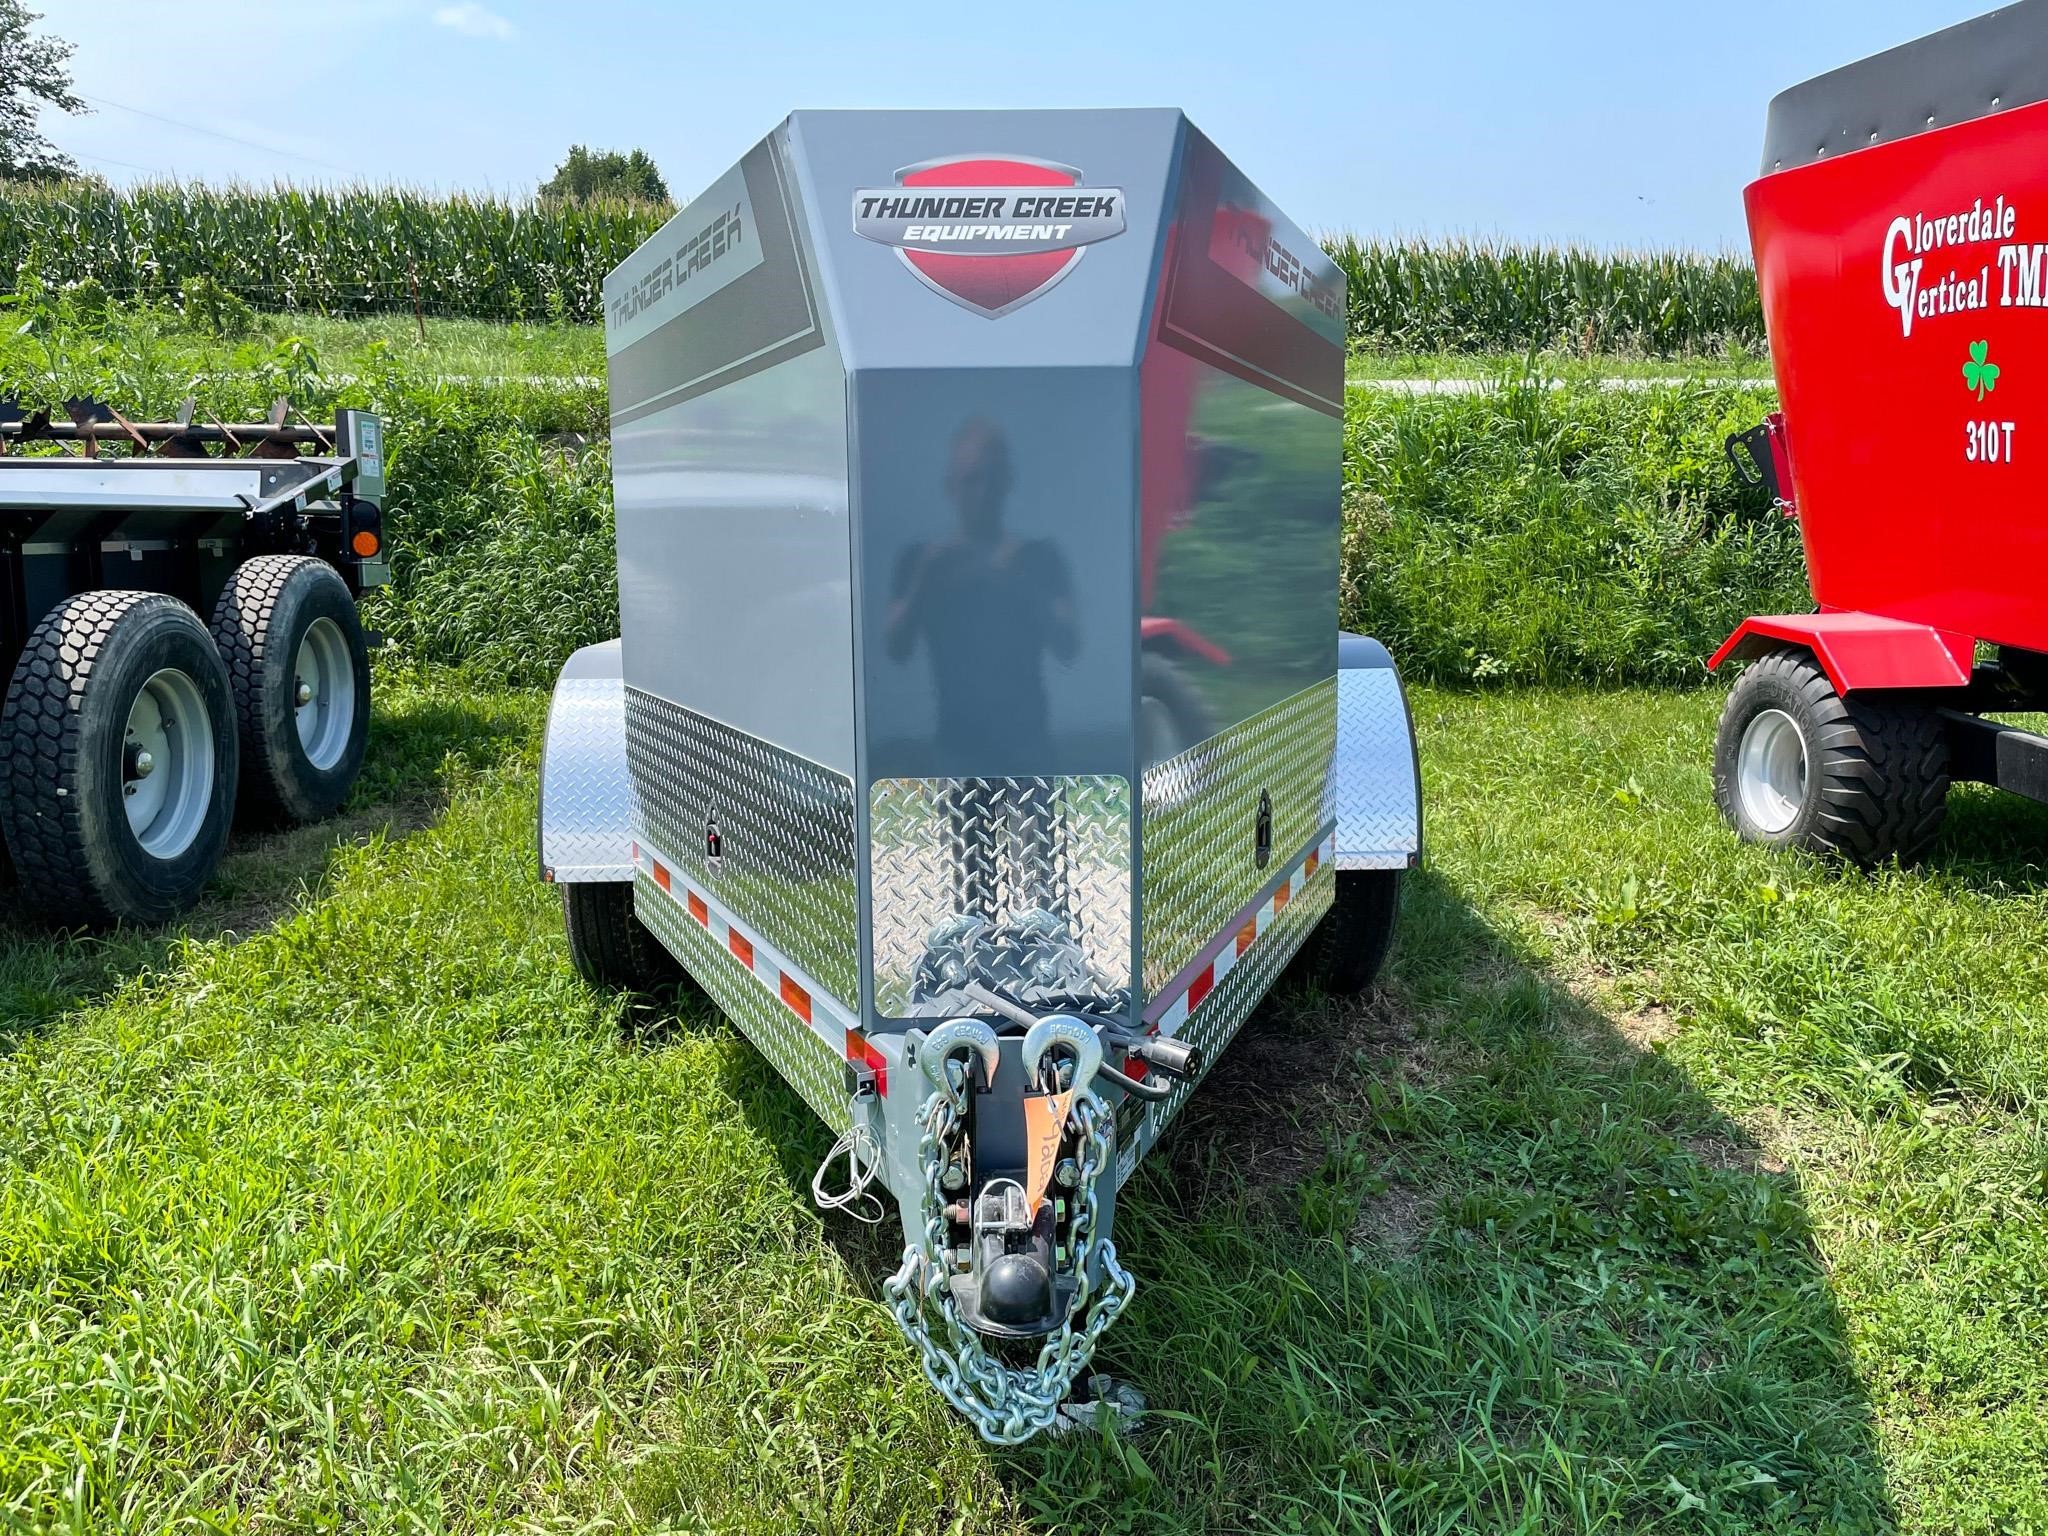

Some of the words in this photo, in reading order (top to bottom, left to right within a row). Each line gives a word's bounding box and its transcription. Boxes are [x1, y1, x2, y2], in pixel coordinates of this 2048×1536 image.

[861, 197, 1007, 219] THUNDER
[1012, 196, 1117, 218] CREEK
[902, 224, 1073, 242] EQUIPMENT
[610, 258, 673, 330] THUNDER
[676, 201, 742, 287] CREEK
[1882, 194, 2016, 308] Cloverdale
[1894, 258, 1990, 338] Vertical
